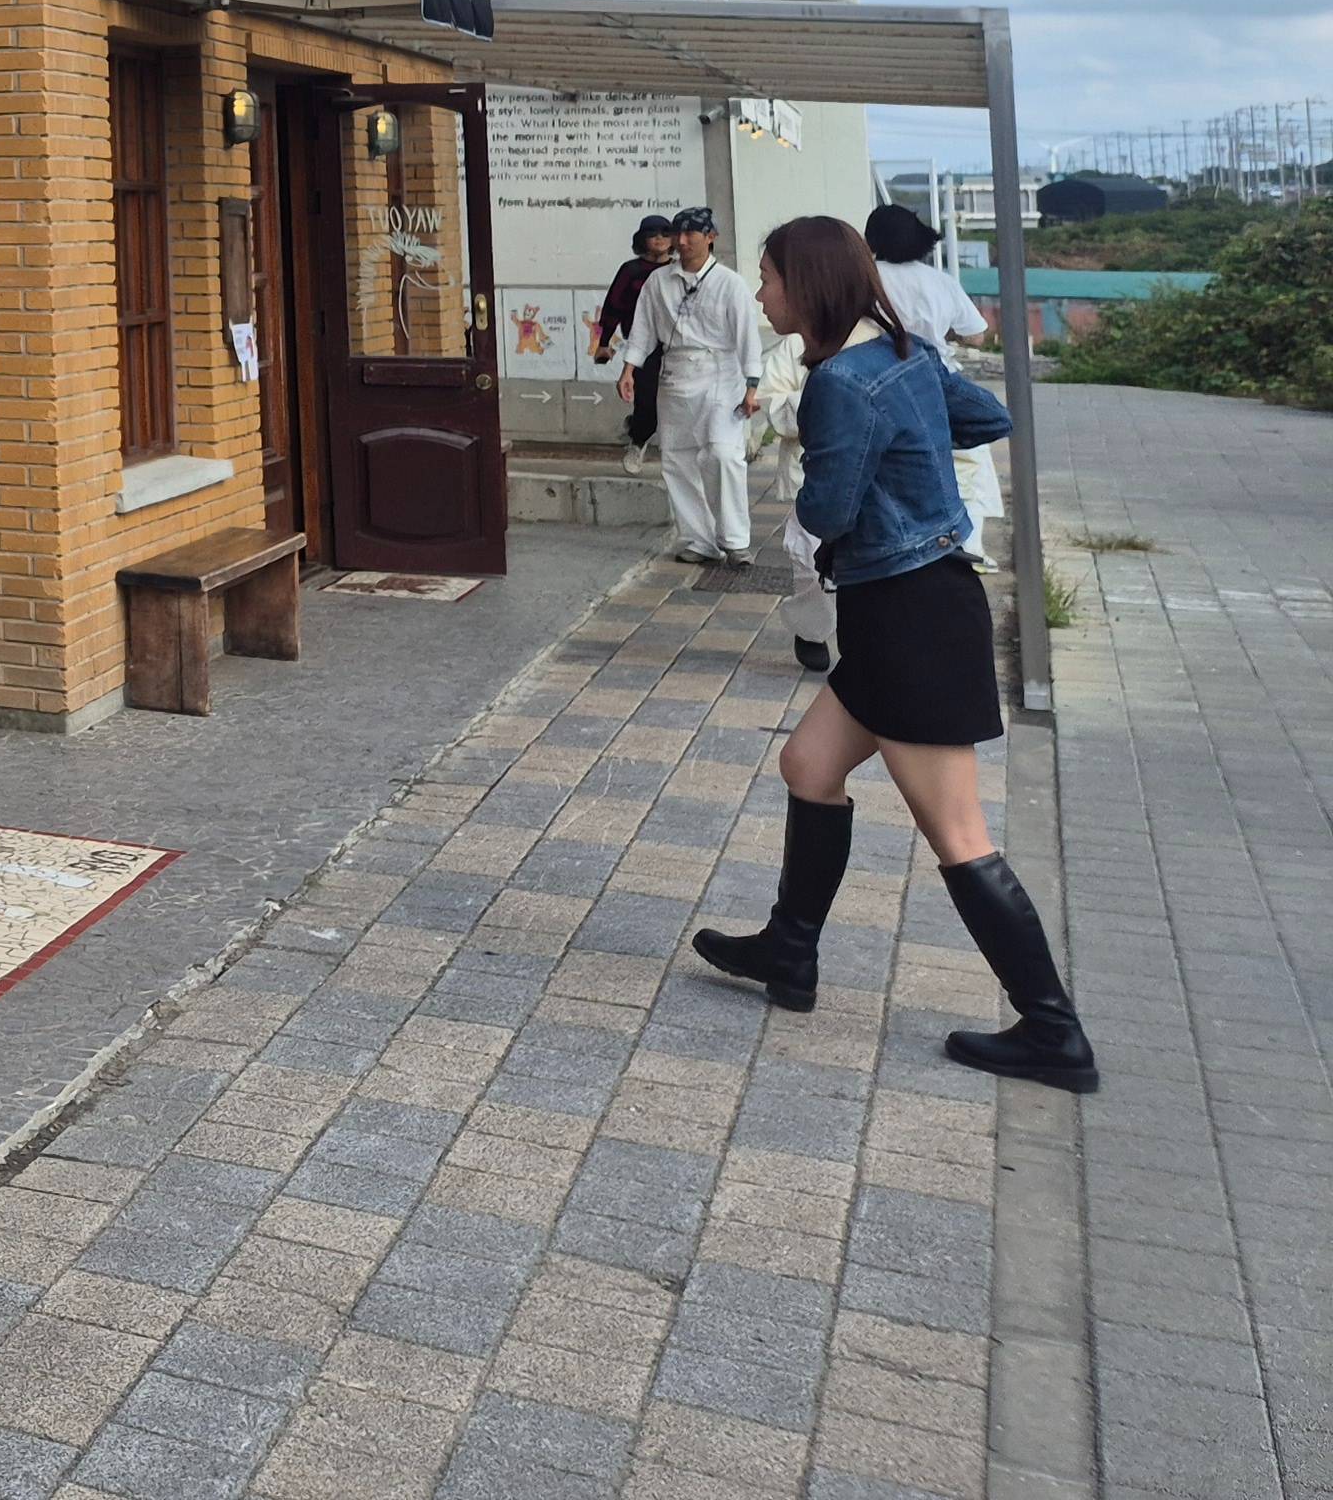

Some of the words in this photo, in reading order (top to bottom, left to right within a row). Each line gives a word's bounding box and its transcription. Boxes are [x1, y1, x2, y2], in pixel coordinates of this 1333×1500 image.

[613, 106, 644, 117] green
[648, 105, 681, 116] plants
[521, 119, 549, 129] What
[558, 118, 580, 128] love
[583, 118, 600, 128] the
[603, 119, 630, 128] most
[492, 132, 509, 142] the
[514, 132, 560, 143] morning
[565, 131, 591, 141] with
[597, 131, 615, 141] hot
[620, 131, 655, 141] coffee
[660, 132, 682, 141] and
[605, 145, 639, 155] would
[643, 145, 666, 155] love
[670, 145, 682, 155] to
[499, 159, 520, 169] like
[652, 160, 683, 169] come
[515, 173, 538, 183] your
[540, 173, 572, 182] warm
[498, 196, 524, 208] from
